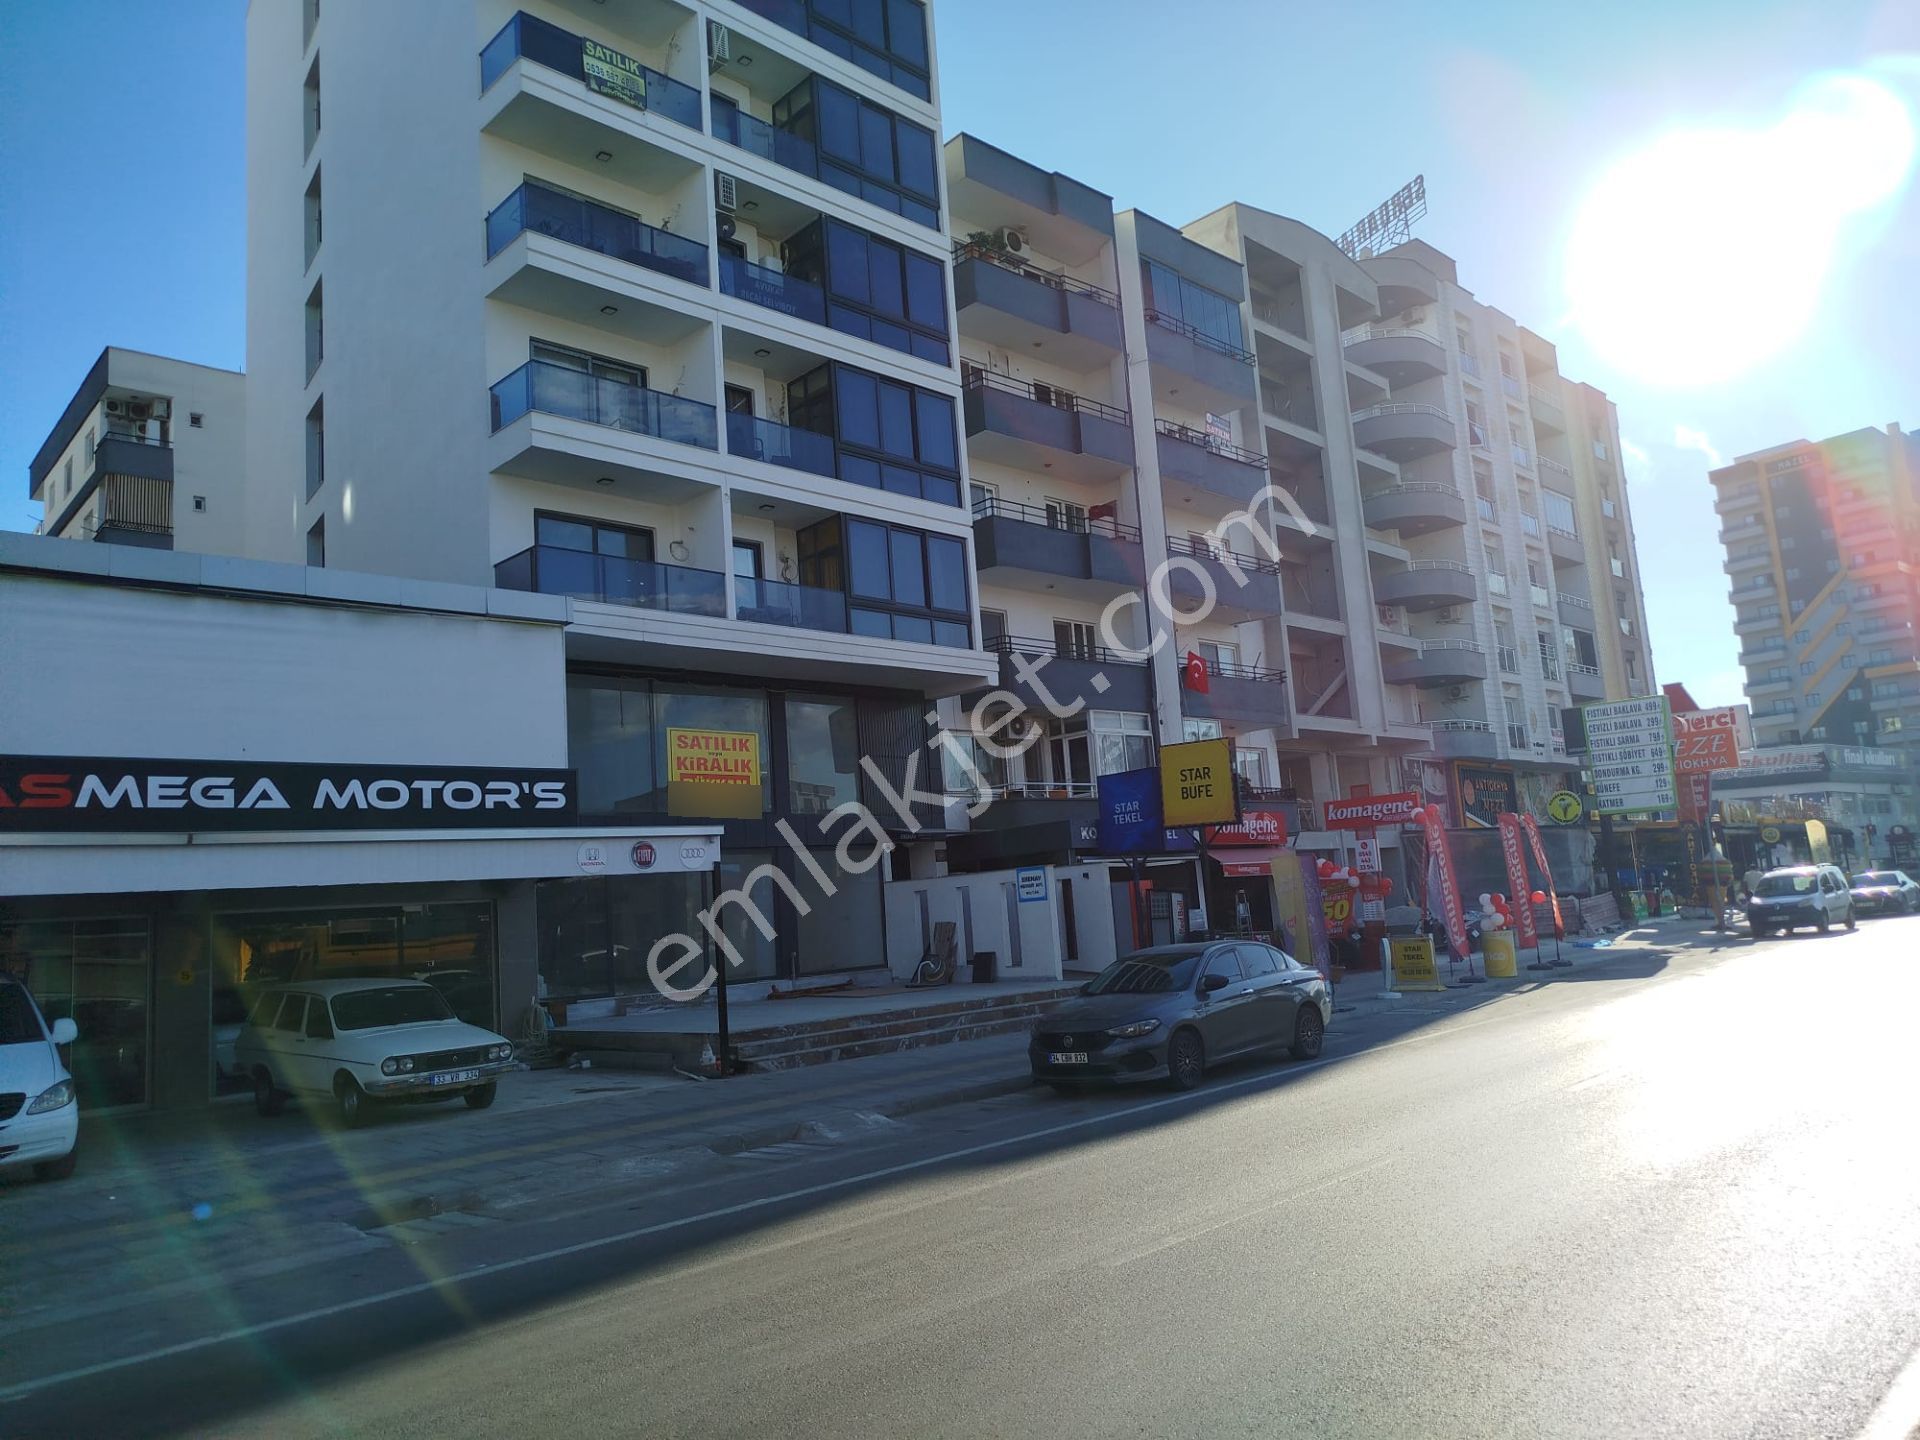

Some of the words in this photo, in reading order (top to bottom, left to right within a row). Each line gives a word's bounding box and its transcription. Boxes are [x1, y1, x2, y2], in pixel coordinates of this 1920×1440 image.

[586, 41, 640, 75] SATILIK
[1614, 719, 1642, 731] BAKLAVA
[677, 735, 751, 752] SATILIK
[1617, 734, 1640, 745] SARMA
[1180, 767, 1211, 783] STAR
[313, 778, 566, 810] MOTOR'S
[1114, 801, 1140, 814] STAR
[1328, 800, 1413, 821] komagene
[1113, 813, 1144, 825] TEKEL
[637, 849, 651, 862] FIAT
